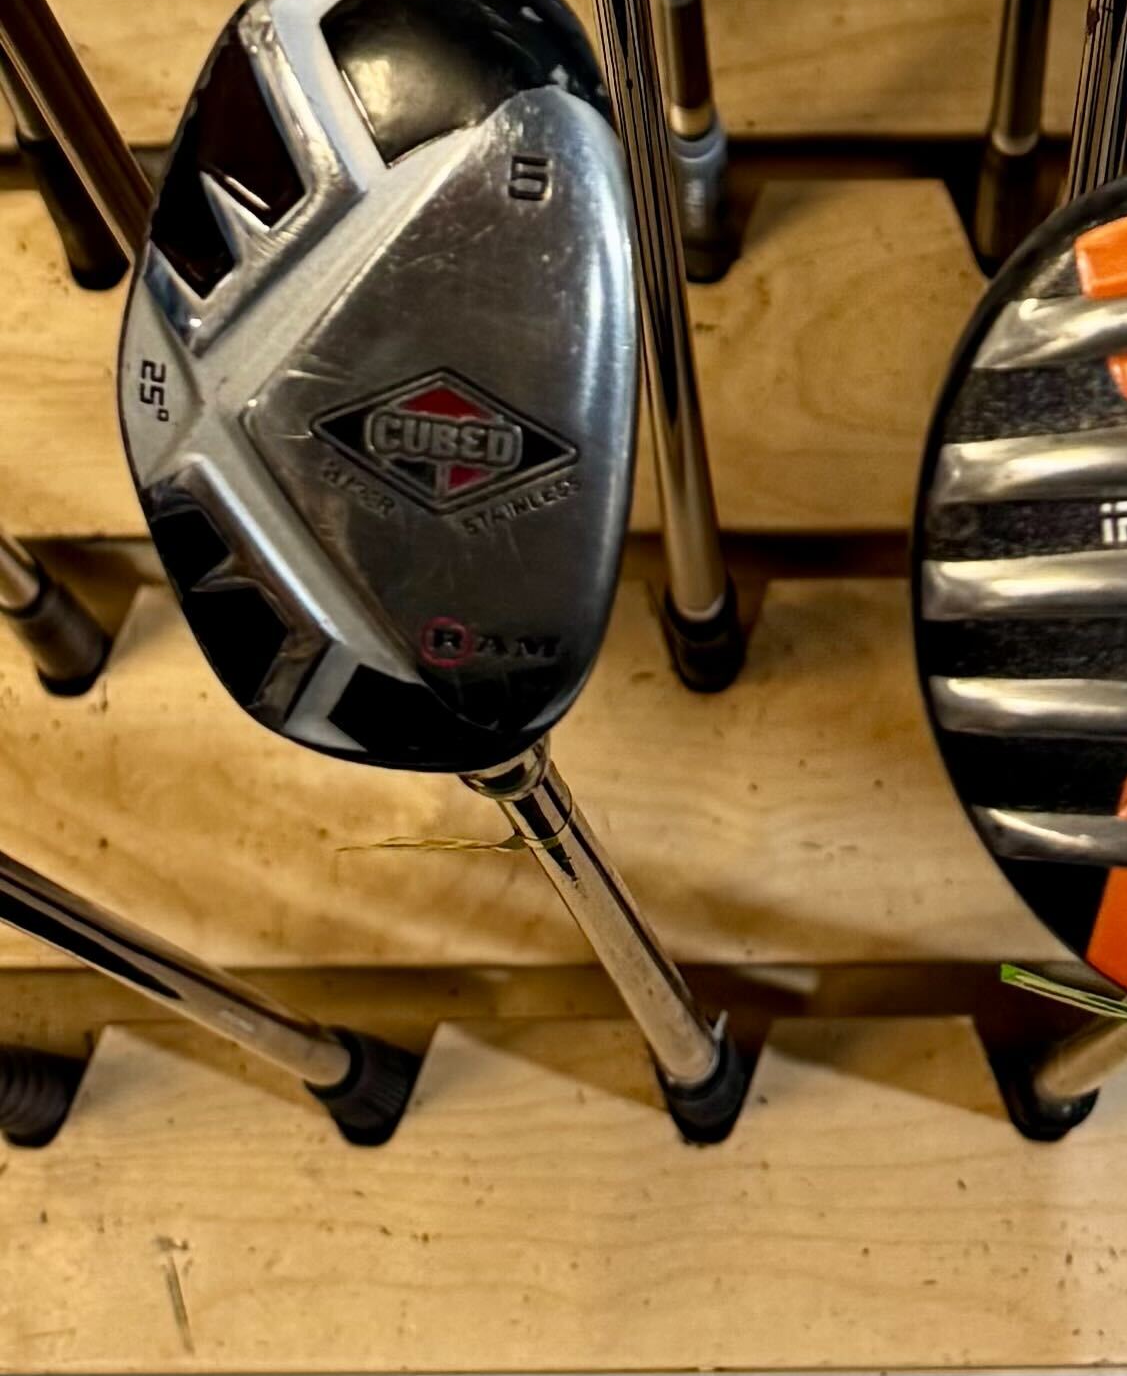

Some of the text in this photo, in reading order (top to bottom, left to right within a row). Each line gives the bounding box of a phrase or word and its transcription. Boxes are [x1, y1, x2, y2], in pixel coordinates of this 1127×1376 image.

[507, 154, 553, 202] 5
[138, 360, 171, 424] 25°
[371, 415, 516, 467] CUBED
